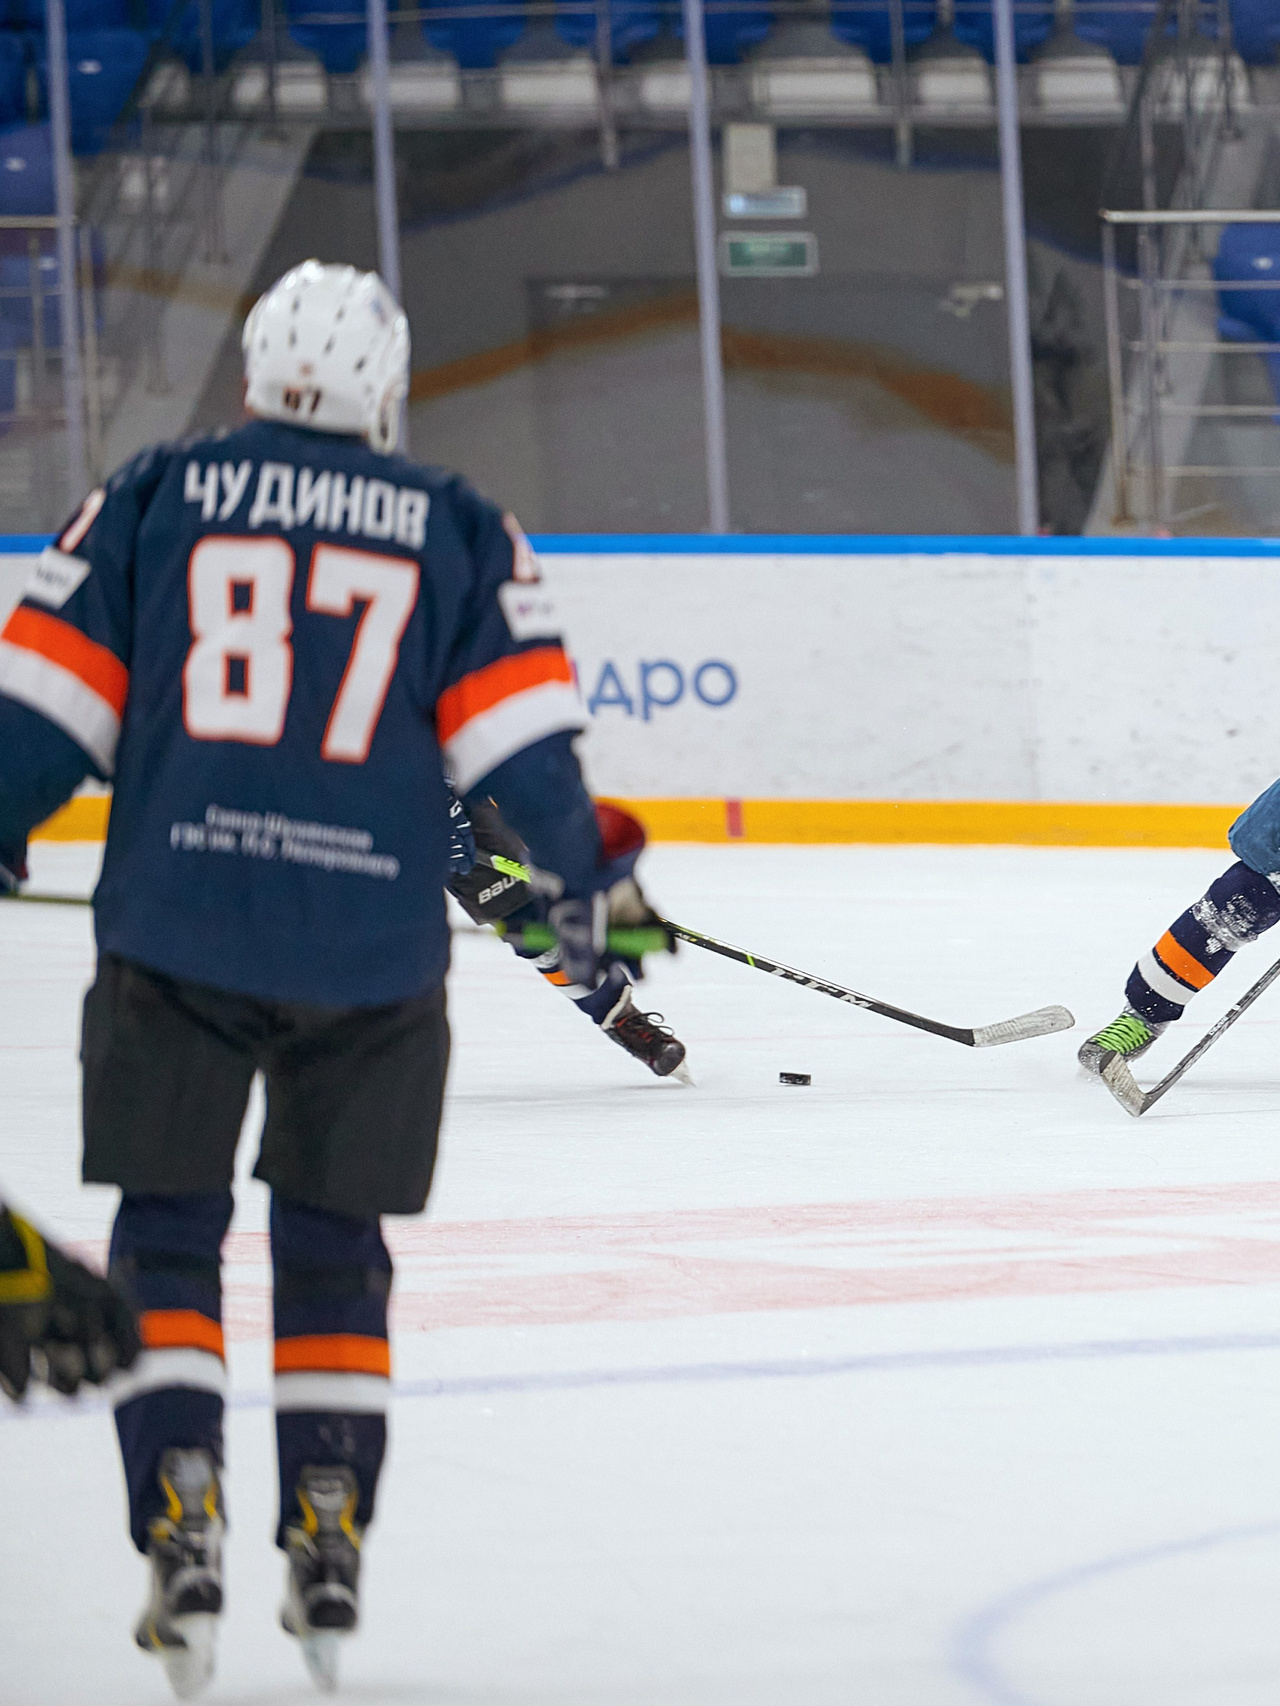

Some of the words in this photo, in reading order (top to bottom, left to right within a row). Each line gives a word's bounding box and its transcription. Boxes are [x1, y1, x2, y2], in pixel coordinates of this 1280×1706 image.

[183, 460, 431, 553] ЧУДИНОВ
[182, 533, 421, 765] 87
[570, 659, 739, 722] дро
[477, 876, 522, 905] BAU
